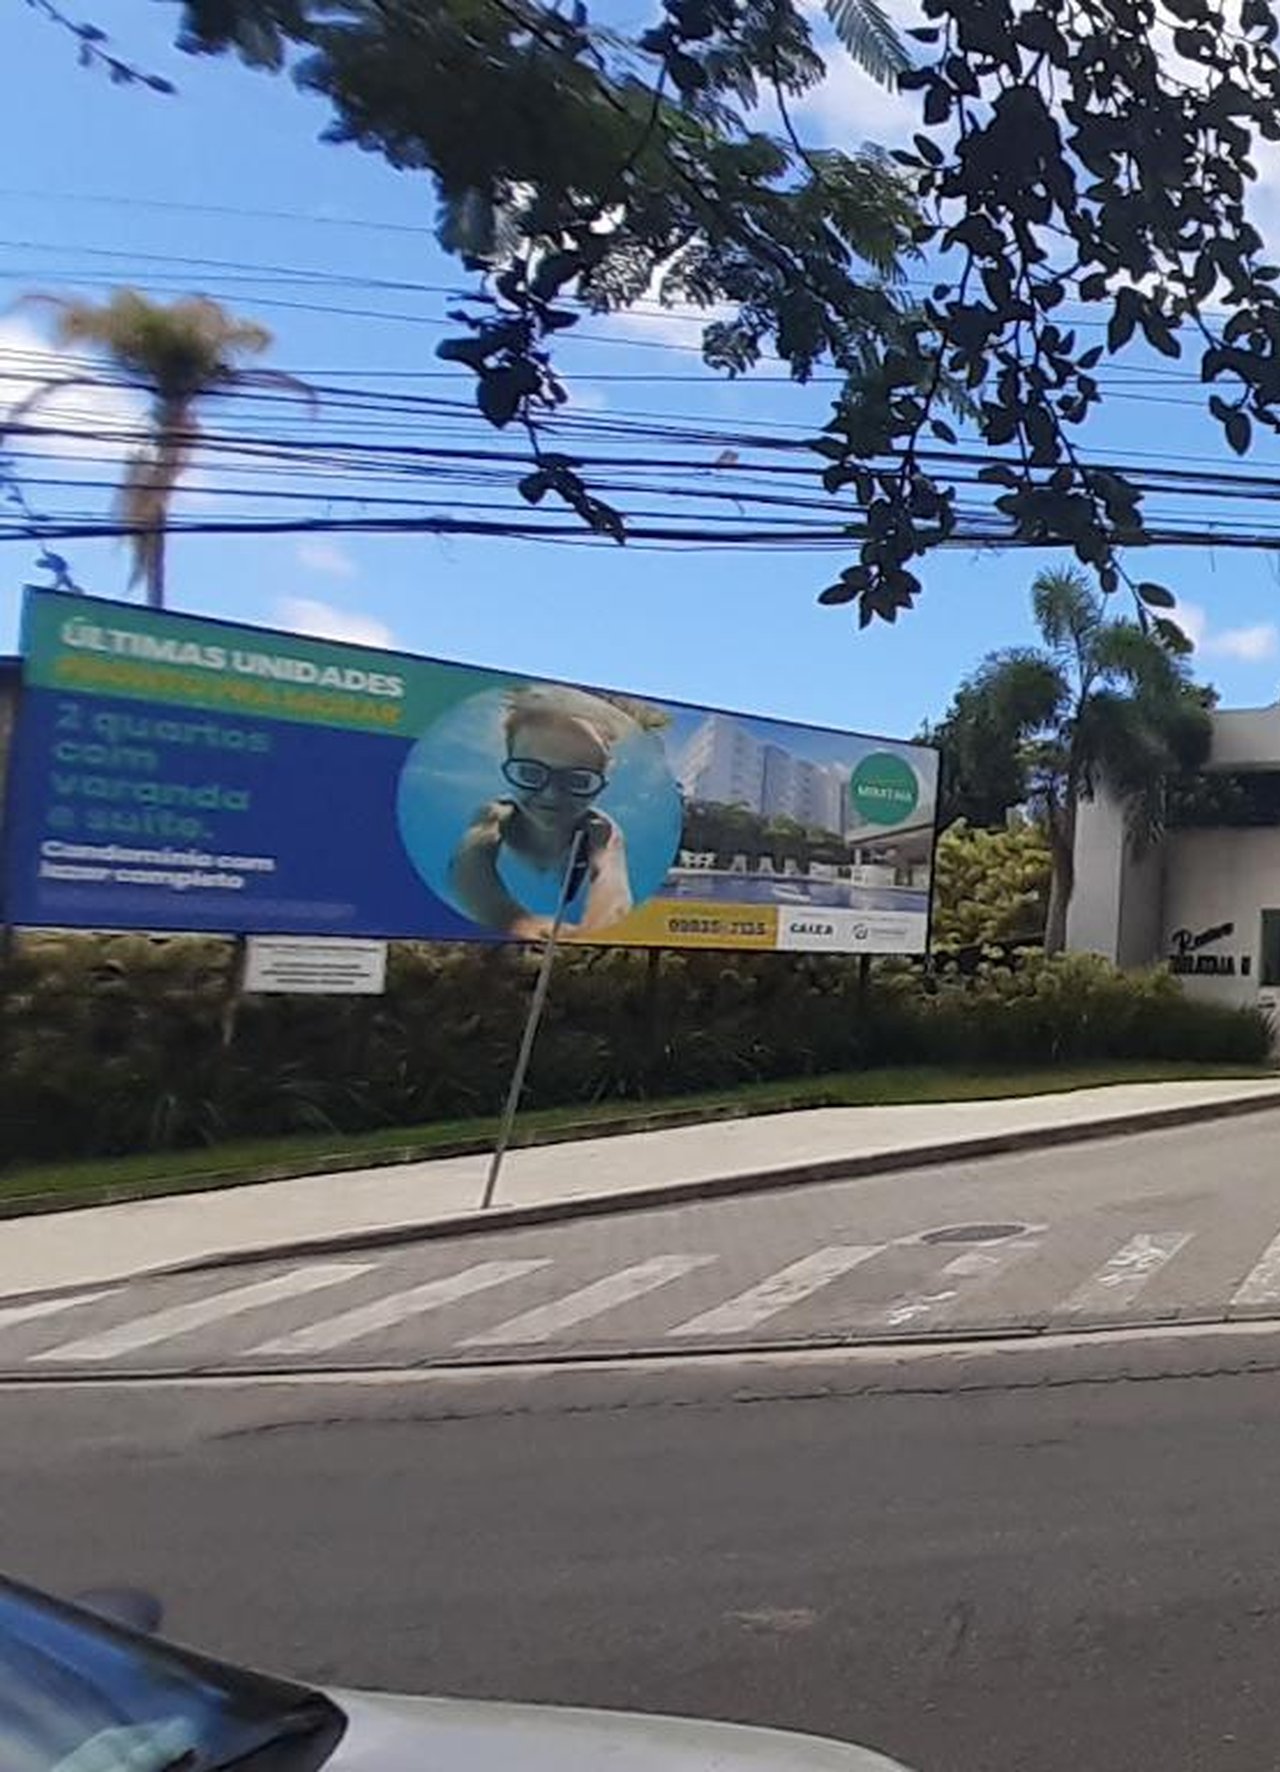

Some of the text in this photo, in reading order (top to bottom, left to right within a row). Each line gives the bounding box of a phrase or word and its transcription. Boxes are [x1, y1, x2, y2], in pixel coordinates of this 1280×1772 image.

[62, 616, 404, 698] ÚLTIMAS UNIDADES
[56, 702, 272, 753] 2 quartos
[56, 741, 159, 770] com
[50, 770, 250, 812] varanda
[114, 868, 245, 891] completo
[216, 854, 276, 873] com
